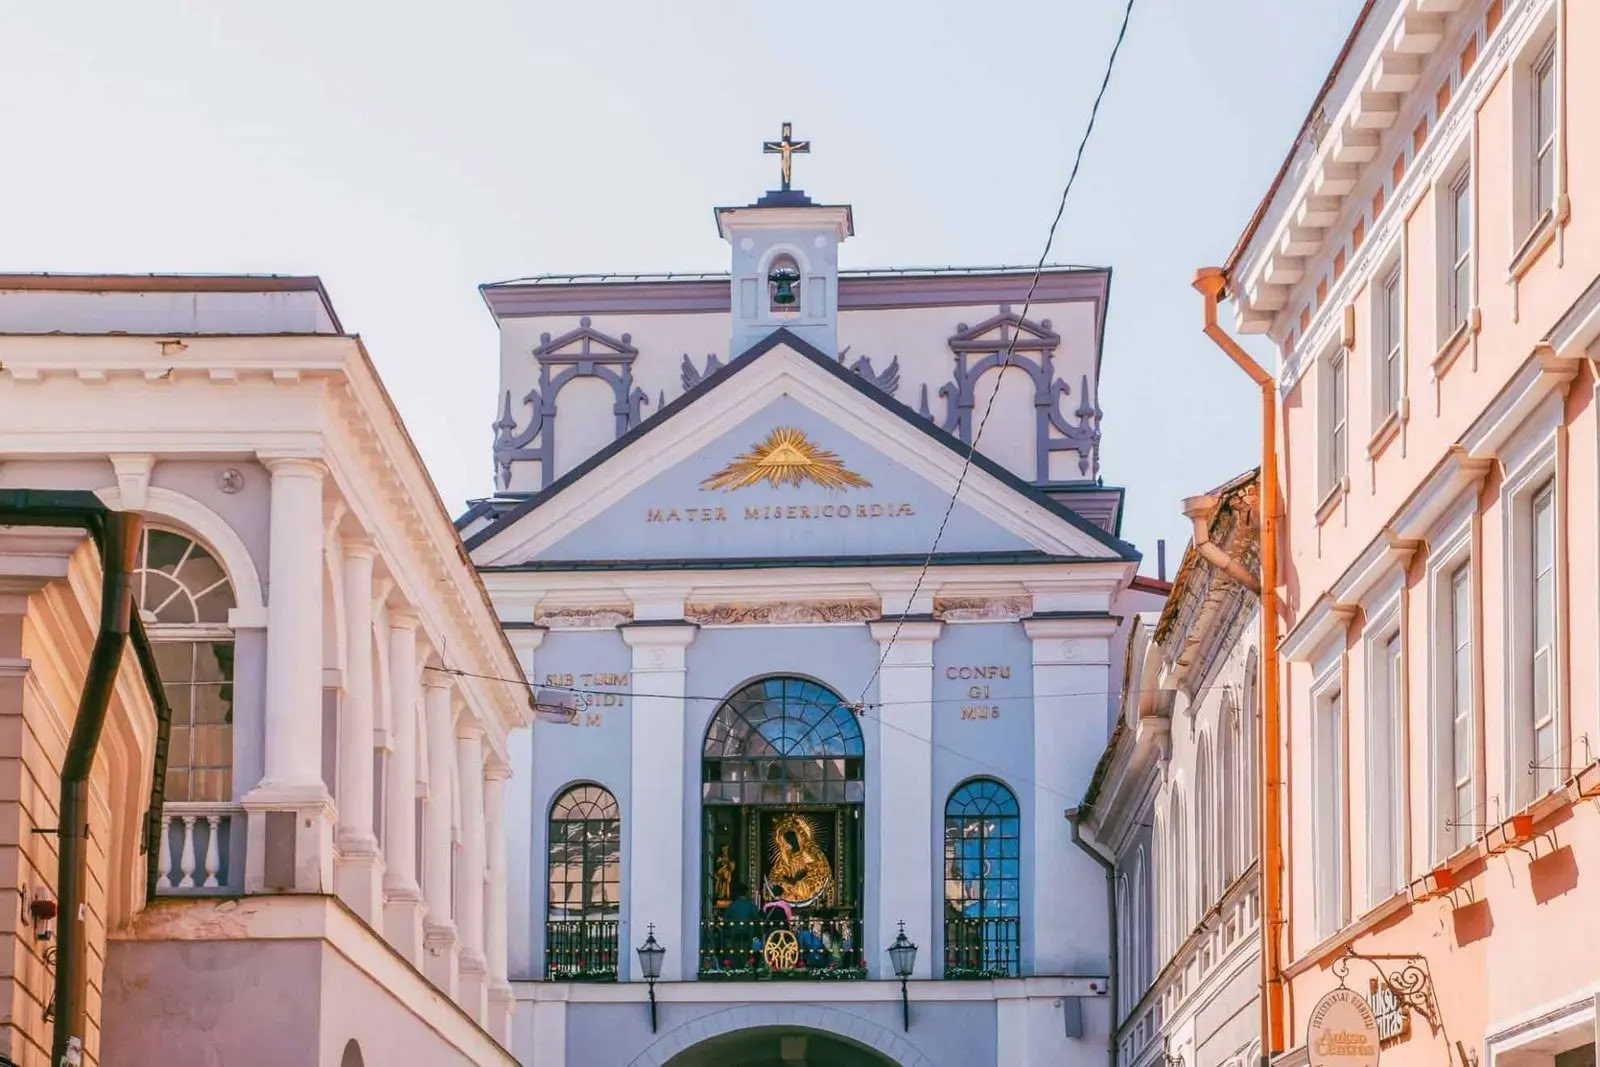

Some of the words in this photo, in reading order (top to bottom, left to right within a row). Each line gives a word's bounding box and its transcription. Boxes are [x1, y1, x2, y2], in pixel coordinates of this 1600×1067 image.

[646, 507, 727, 522] MATER
[744, 503, 916, 521] MISERICORDIÆ
[545, 672, 574, 687] SUB
[579, 672, 628, 687] TUUM
[946, 666, 1010, 680] CONFU
[969, 685, 989, 699] GI
[960, 704, 1000, 720] MUS
